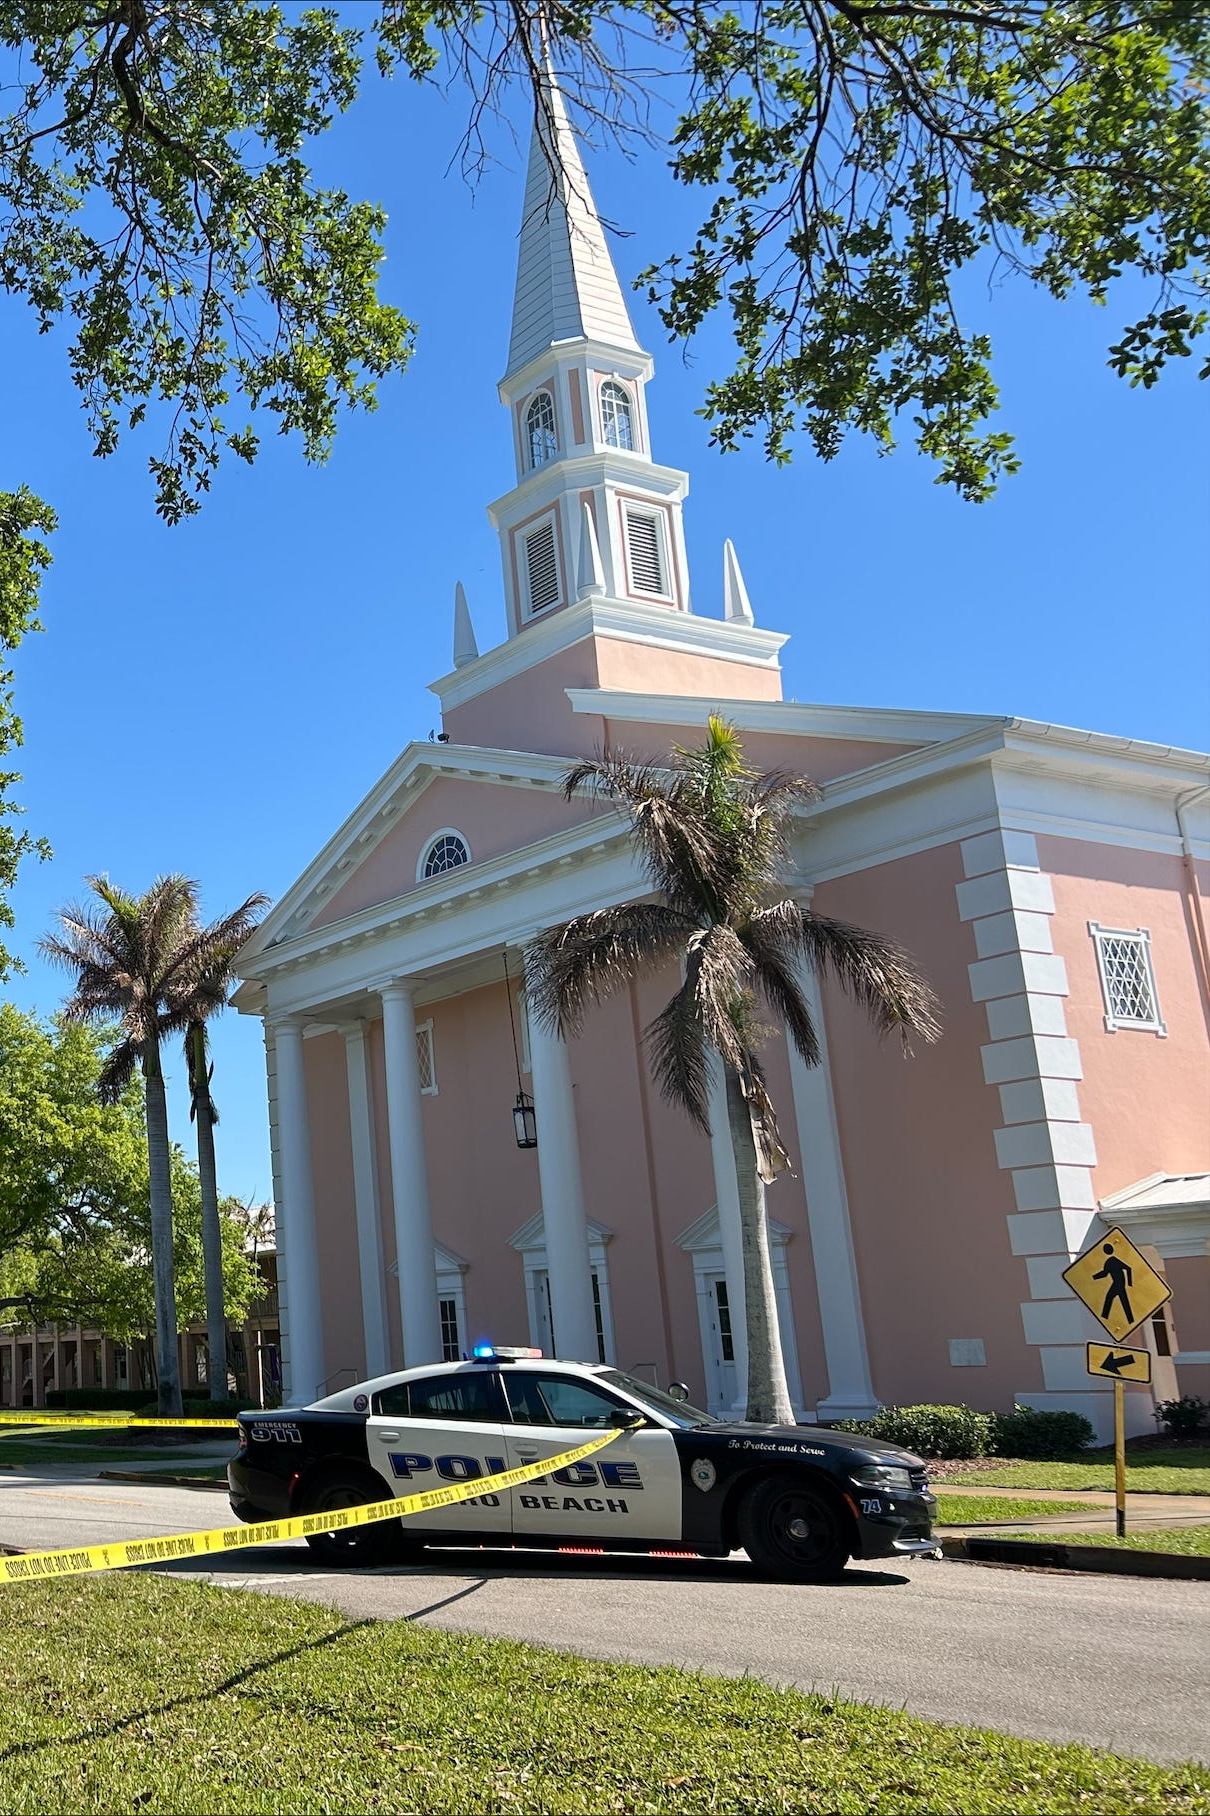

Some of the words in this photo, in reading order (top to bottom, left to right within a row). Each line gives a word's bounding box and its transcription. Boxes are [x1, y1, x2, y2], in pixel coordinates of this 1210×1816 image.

[251, 1427, 302, 1443] 911
[728, 1439, 740, 1448] To
[742, 1440, 777, 1450] Protect
[778, 1444, 797, 1452] and
[799, 1445, 826, 1456] Serve
[520, 1495, 629, 1513] BEACH
[860, 1499, 882, 1514] 74
[5, 1560, 30, 1578] CROSS
[29, 1558, 45, 1575] NOT
[43, 1557, 56, 1573] DO
[54, 1555, 71, 1572] LINE
[69, 1552, 92, 1569] POLICE
